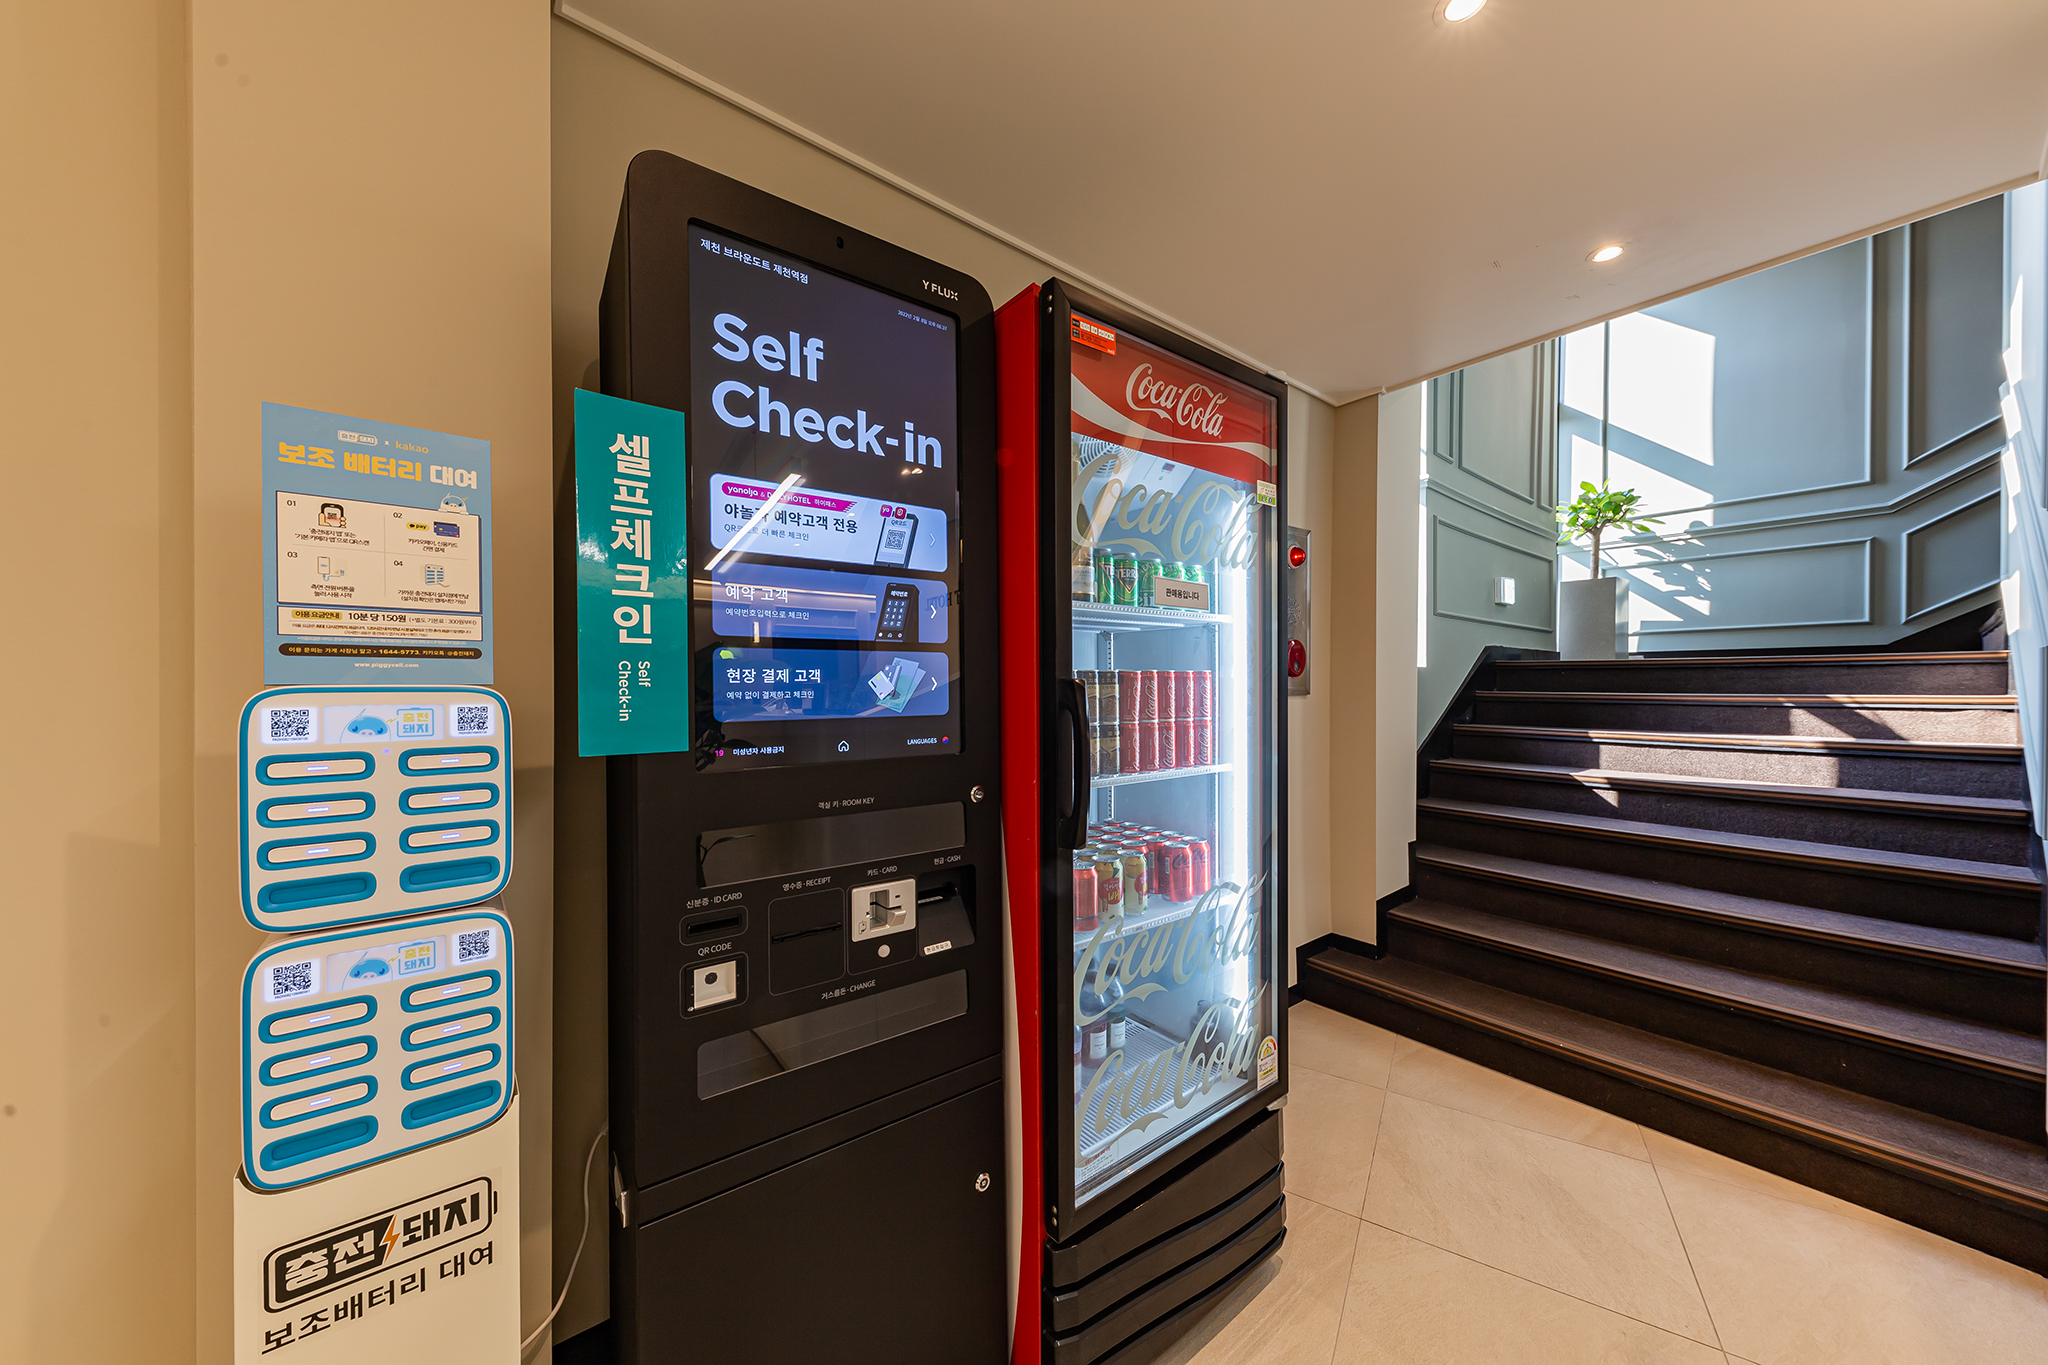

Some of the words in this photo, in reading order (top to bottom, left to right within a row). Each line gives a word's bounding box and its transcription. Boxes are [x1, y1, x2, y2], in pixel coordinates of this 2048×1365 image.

[701, 239, 720, 254] 제천
[724, 247, 771, 271] 브라운도트
[773, 264, 808, 285] 제천역점
[932, 283, 958, 301] FLUX
[712, 313, 824, 382] Self
[1126, 362, 1229, 438] Coca-Cola
[712, 380, 942, 468] Check-in
[396, 440, 429, 454] kakao
[278, 442, 335, 469] 보조
[344, 452, 422, 482] 배터리
[430, 465, 477, 490] 대여
[727, 486, 758, 498] yanolja
[767, 491, 811, 505] DYHOTEL
[1071, 454, 1263, 572] Coca-Cola
[775, 510, 828, 530] 예약고객
[833, 518, 858, 534] 전용
[609, 433, 654, 644] 셀프체크인
[788, 532, 809, 541] 체크인
[726, 586, 755, 601] 예약
[761, 588, 788, 604] 고객
[1166, 588, 1200, 601] 판매용입니다
[295, 610, 310, 618] 이용
[349, 613, 368, 621] 10분
[370, 613, 379, 622] 당
[381, 614, 406, 622] 150원
[726, 608, 786, 618] 예약번호입력으로
[788, 611, 810, 620] 체크인
[638, 660, 651, 687] Self
[726, 668, 756, 684] 현장
[762, 668, 789, 684] 결제
[795, 668, 821, 684] 고객
[618, 660, 632, 722] Check-in
[726, 691, 742, 700] 예약
[745, 691, 759, 700] 없이
[762, 691, 791, 700] 결제하고
[793, 691, 814, 699] 체크인
[403, 713, 429, 722] 충전
[403, 724, 428, 734] 돼지
[733, 747, 759, 756] 미성년자
[760, 746, 785, 754] 사용금지
[882, 866, 897, 874] CARD
[806, 876, 831, 887] RECEIPT
[686, 897, 709, 909] 신분증
[714, 896, 721, 904] ID
[722, 892, 742, 902] CARD
[698, 946, 710, 956] QR
[711, 942, 732, 953] CODE
[1074, 870, 1269, 1026] Coca-Cola
[404, 958, 431, 971] 돼지
[850, 979, 876, 992] CHANGE
[1074, 980, 1269, 1168] Coca-Cola
[262, 1267, 426, 1355] 보조배터리
[440, 1241, 493, 1280] 대여
